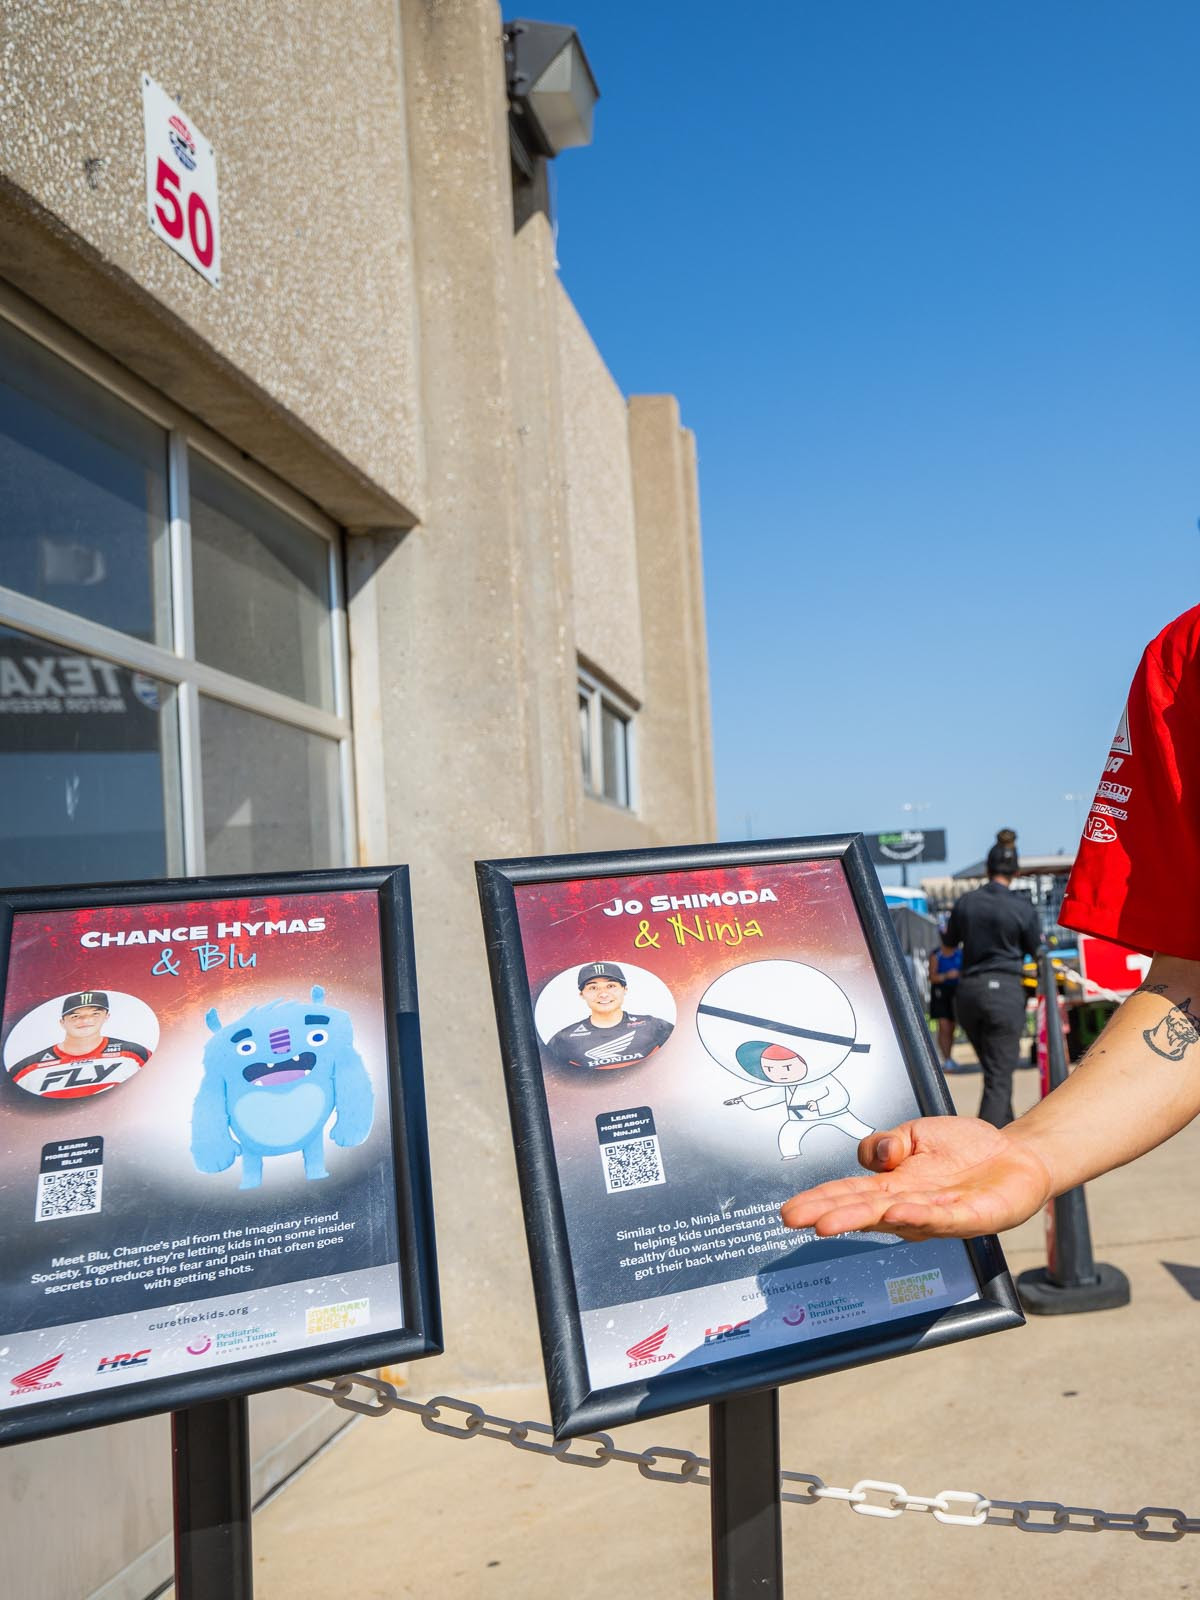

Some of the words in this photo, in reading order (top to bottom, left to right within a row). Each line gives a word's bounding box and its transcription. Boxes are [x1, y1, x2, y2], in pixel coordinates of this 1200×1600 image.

[154, 155, 214, 269] 50
[650, 888, 778, 912] SHIMODA
[80, 925, 209, 948] CHANCE
[217, 917, 326, 938] HYMAS
[634, 920, 661, 948] &
[666, 913, 764, 946] Ninja
[152, 948, 181, 976] &
[191, 942, 258, 972] Blu
[587, 1052, 644, 1067] HONDA
[39, 1062, 123, 1092] FLY
[600, 1123, 622, 1132] MORE
[624, 1118, 650, 1128] ABOUT
[610, 1113, 638, 1122] LEARN
[44, 1152, 70, 1160] MORE
[70, 1148, 100, 1157] ABOUT
[58, 1142, 88, 1151] LEARN
[616, 1226, 656, 1241] Similar
[658, 1223, 670, 1232] to
[673, 1220, 689, 1230] Jo,
[691, 1214, 720, 1226] Ninja
[722, 1211, 732, 1220] is
[634, 1236, 677, 1251] helping
[679, 1230, 702, 1242] kids
[704, 1214, 766, 1236] understand
[31, 1268, 82, 1284] Society.
[84, 1259, 141, 1276] Together,
[144, 1251, 185, 1264] they're
[188, 1243, 225, 1258] letting
[228, 1237, 252, 1250] kids
[254, 1236, 264, 1246] in
[267, 1235, 282, 1243] on
[284, 1228, 316, 1240] some
[318, 1221, 356, 1235] insider
[52, 1255, 85, 1268] Meet
[88, 1251, 111, 1262] Blu,
[113, 1240, 170, 1258] Chance's
[172, 1236, 190, 1250] pal
[192, 1233, 220, 1244] from
[223, 1229, 242, 1239] the
[245, 1220, 302, 1235] Imaginary
[304, 1211, 339, 1226] Friend
[620, 1251, 666, 1268] stealthy
[668, 1246, 690, 1258] duo
[692, 1240, 726, 1253] wants
[728, 1232, 762, 1248] young
[44, 1279, 92, 1294] secrets
[95, 1276, 108, 1286] to
[111, 1269, 154, 1283] reduce
[156, 1265, 177, 1275] the
[179, 1260, 203, 1271] fear
[205, 1255, 228, 1267] and
[230, 1252, 256, 1264] pain
[258, 1247, 282, 1258] that
[284, 1241, 315, 1252] often
[317, 1236, 344, 1249] goes
[634, 1268, 655, 1280] got
[656, 1260, 684, 1274] their
[686, 1254, 713, 1268] back
[714, 1247, 745, 1261] when
[747, 1240, 788, 1255] dealing
[788, 1233, 812, 1246] with
[144, 1277, 171, 1290] with
[173, 1270, 216, 1288] getting
[218, 1264, 255, 1278] shots.
[741, 1275, 832, 1302] curethekids.org
[808, 1297, 847, 1310] Pediatric
[810, 1308, 834, 1318] Brain
[835, 1301, 864, 1312] Tumor
[148, 1306, 249, 1331] curethekids.org
[216, 1326, 261, 1340] Pediatric
[216, 1338, 244, 1348] Brain
[246, 1331, 278, 1342] Tumor
[628, 1352, 676, 1369] HONDA
[10, 1381, 64, 1396] HONDA
